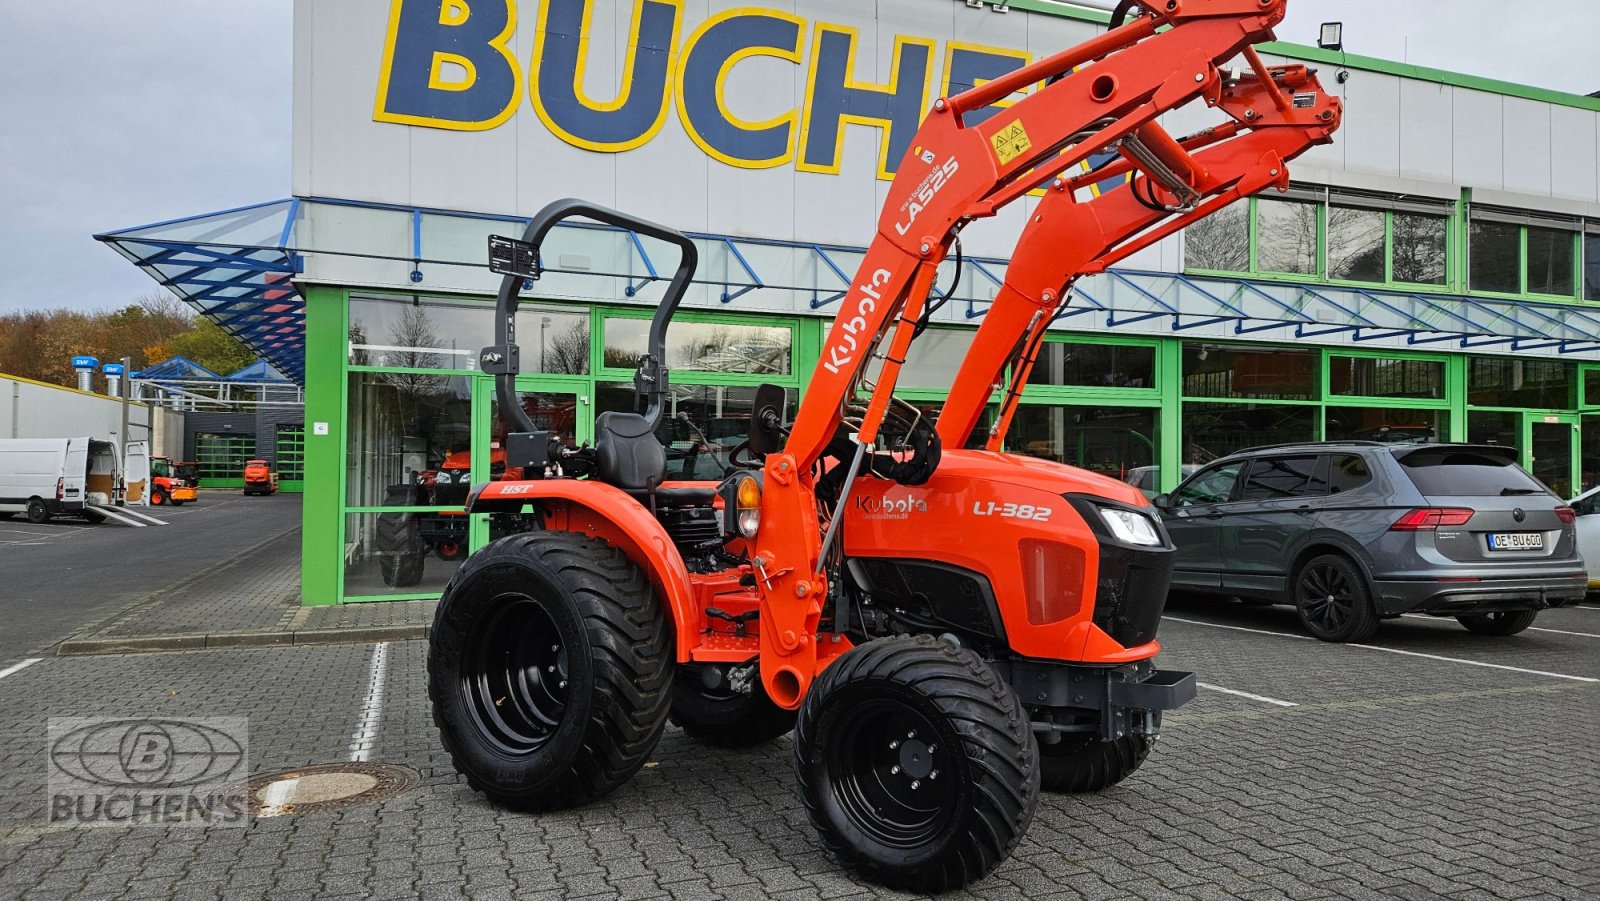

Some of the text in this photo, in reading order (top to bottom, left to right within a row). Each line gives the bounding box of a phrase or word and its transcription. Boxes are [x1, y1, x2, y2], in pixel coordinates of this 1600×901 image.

[895, 155, 959, 235] LA525
[823, 268, 892, 375] Kubota
[499, 484, 534, 494] HST
[856, 494, 927, 513] Kubota
[973, 501, 1052, 522] L1-382
